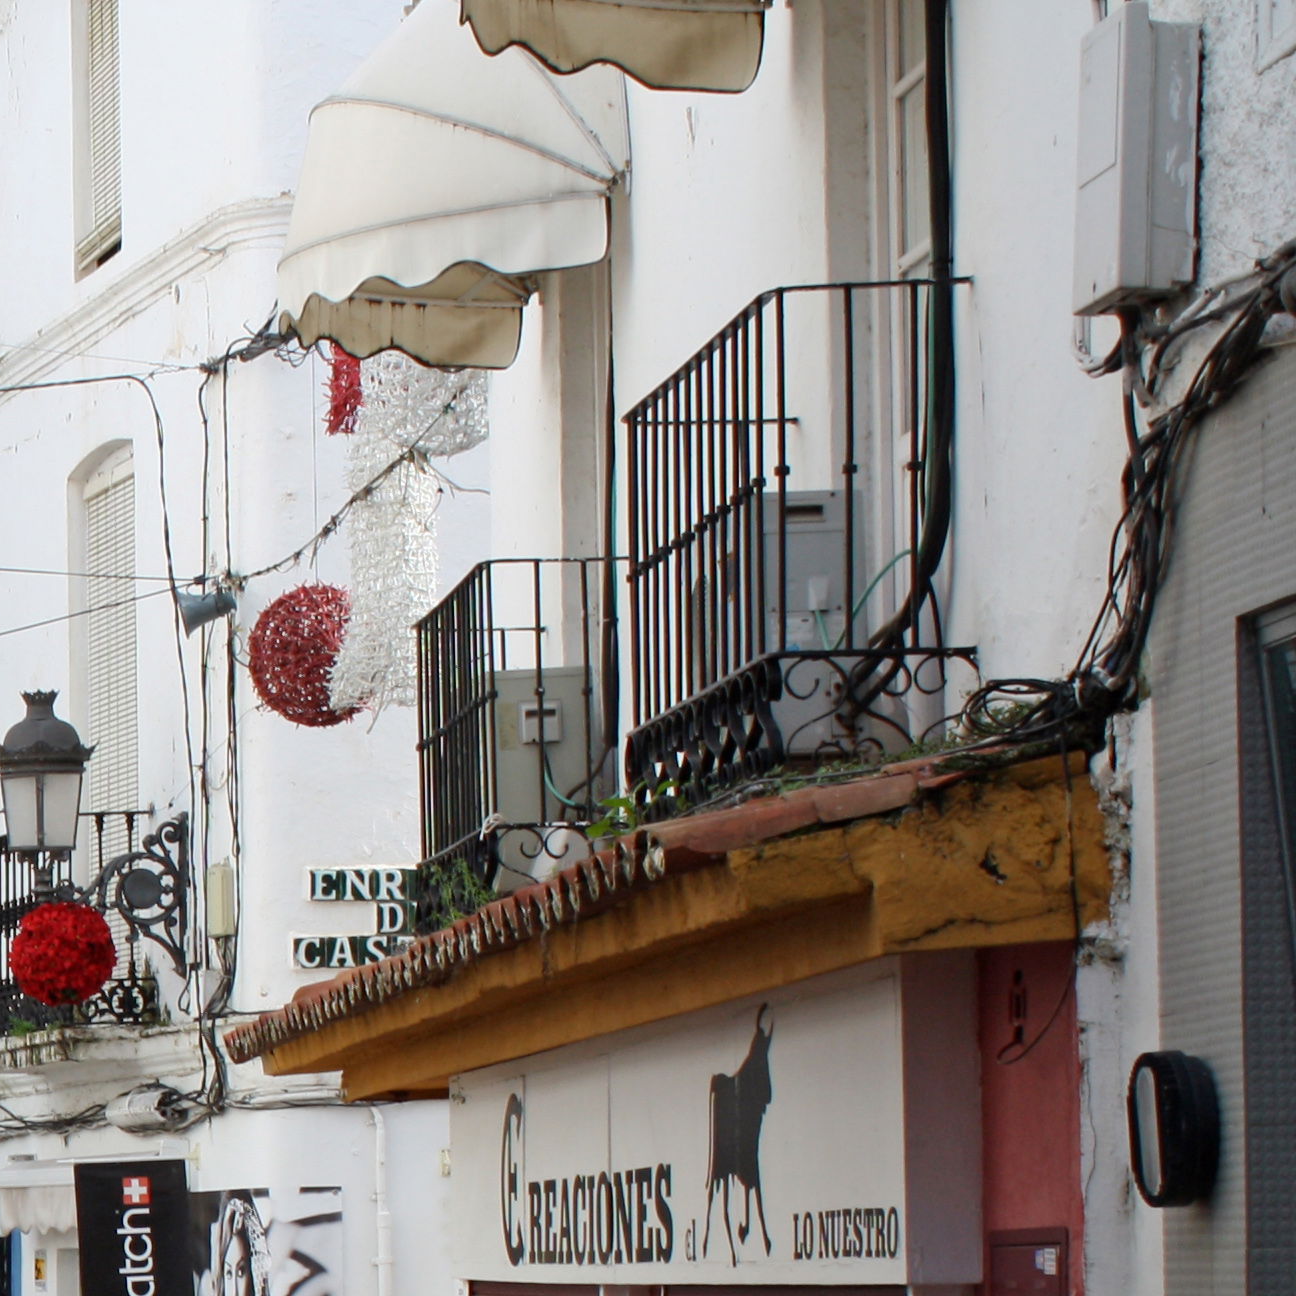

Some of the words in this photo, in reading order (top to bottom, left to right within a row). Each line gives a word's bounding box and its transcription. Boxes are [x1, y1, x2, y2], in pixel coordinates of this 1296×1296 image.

[312, 868, 407, 900] ENR
[378, 902, 417, 933] D
[501, 1093, 674, 1266] CREACIONES
[793, 1211, 814, 1260] LO
[818, 1206, 899, 1259] NUESTRO
